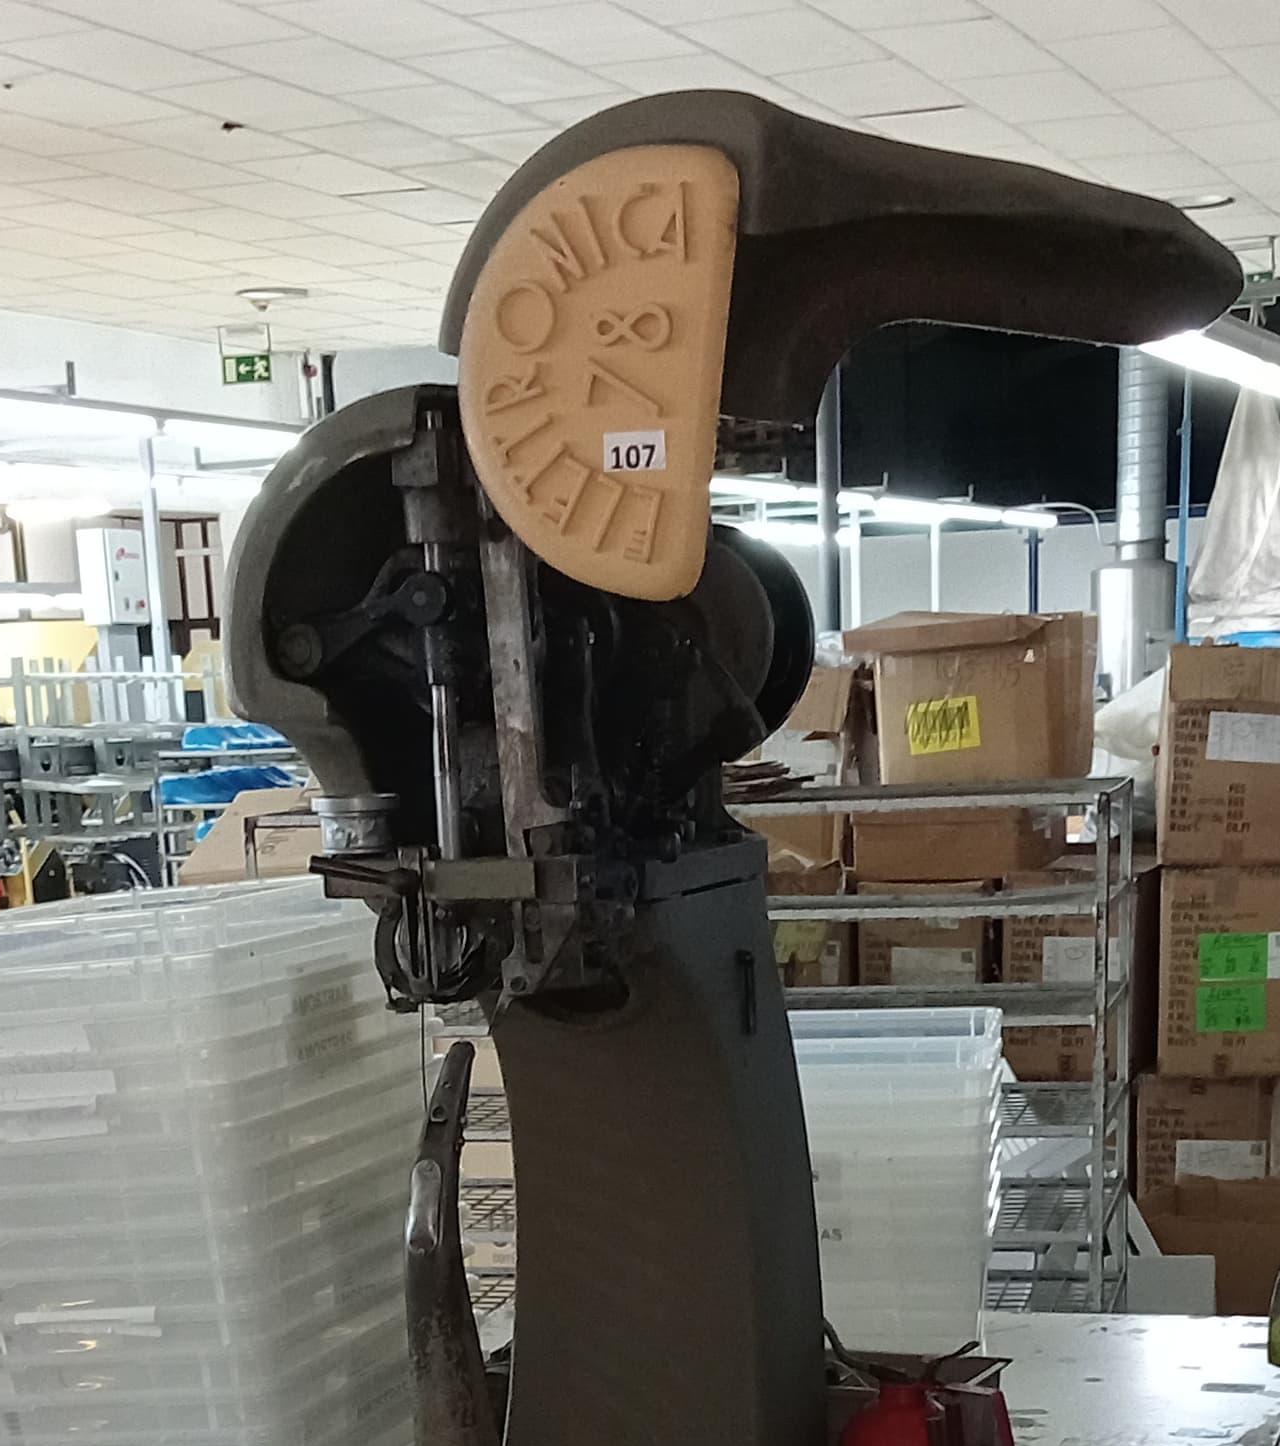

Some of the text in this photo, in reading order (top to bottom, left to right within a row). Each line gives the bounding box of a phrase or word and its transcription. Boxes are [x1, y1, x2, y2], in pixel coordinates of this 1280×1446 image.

[486, 181, 689, 565] ELETTRONICA
[583, 303, 674, 418] 78
[611, 444, 656, 469] 107
